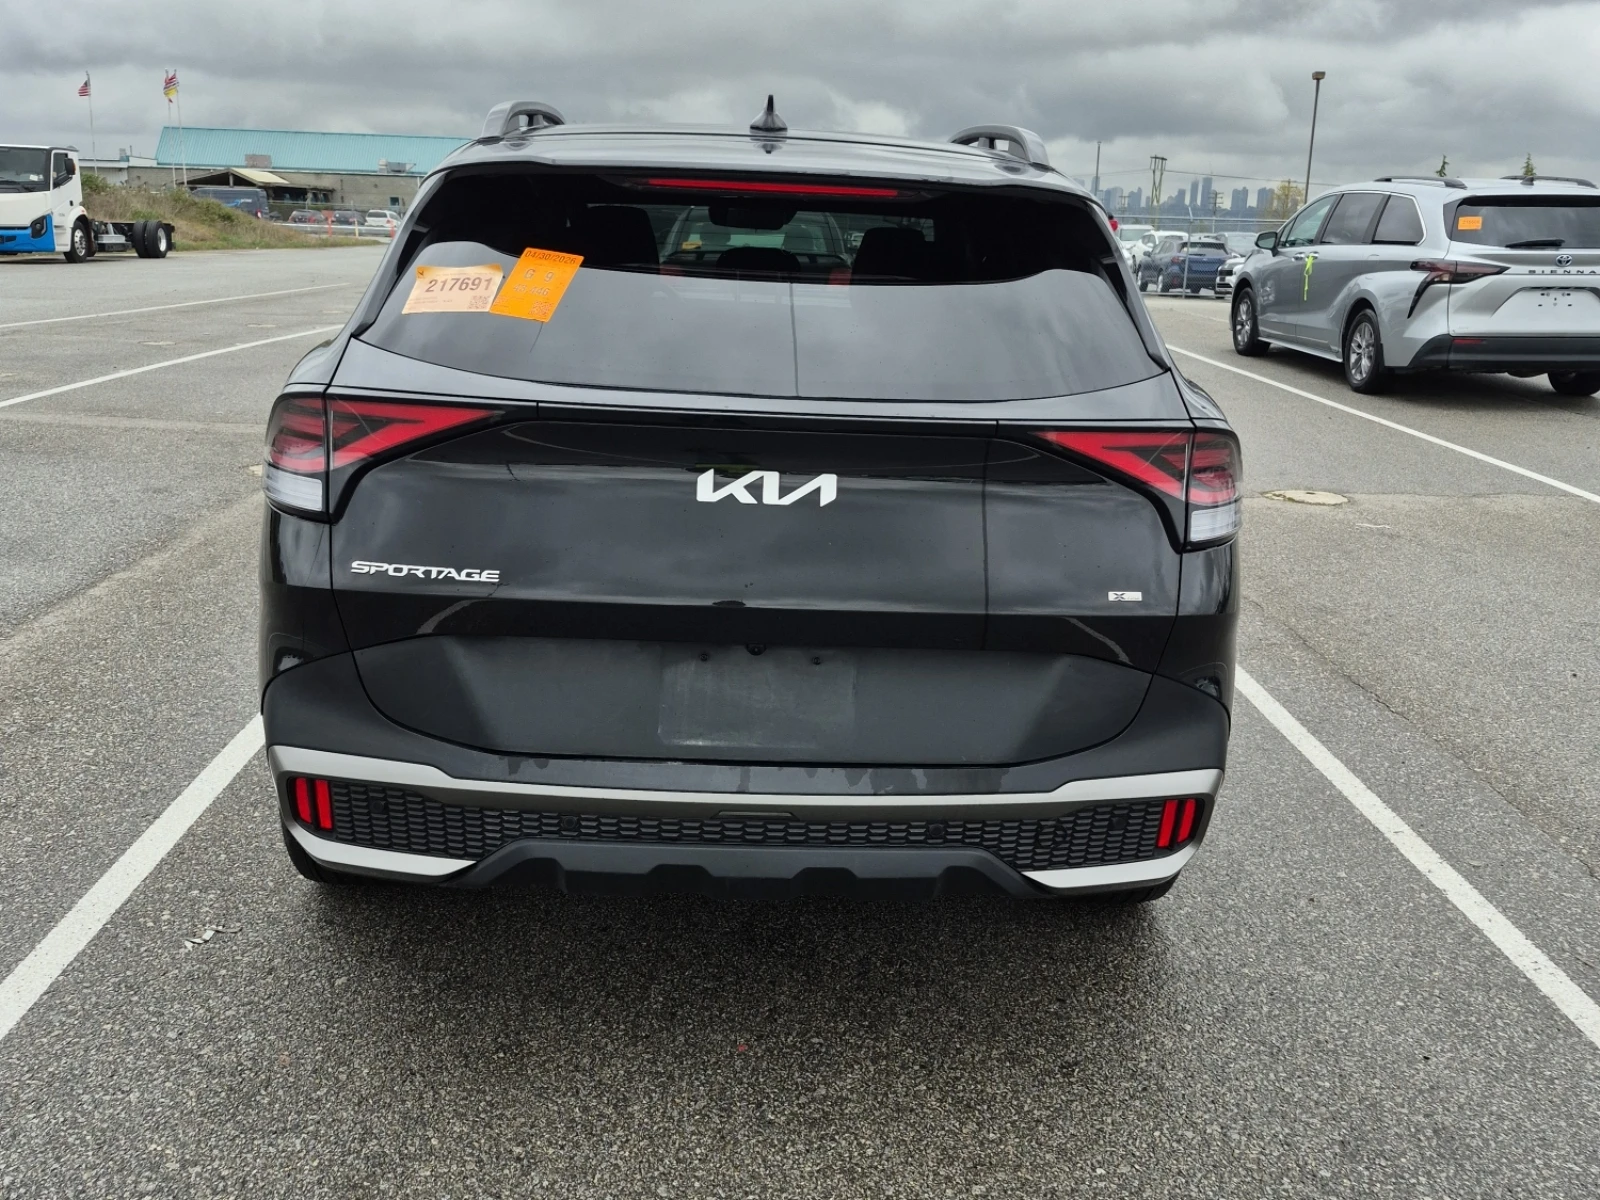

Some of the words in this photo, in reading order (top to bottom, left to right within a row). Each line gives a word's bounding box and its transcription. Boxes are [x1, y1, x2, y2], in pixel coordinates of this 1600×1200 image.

[424, 276, 493, 293] 217691
[696, 468, 838, 507] KIA
[350, 560, 500, 582] SPORTAGE
